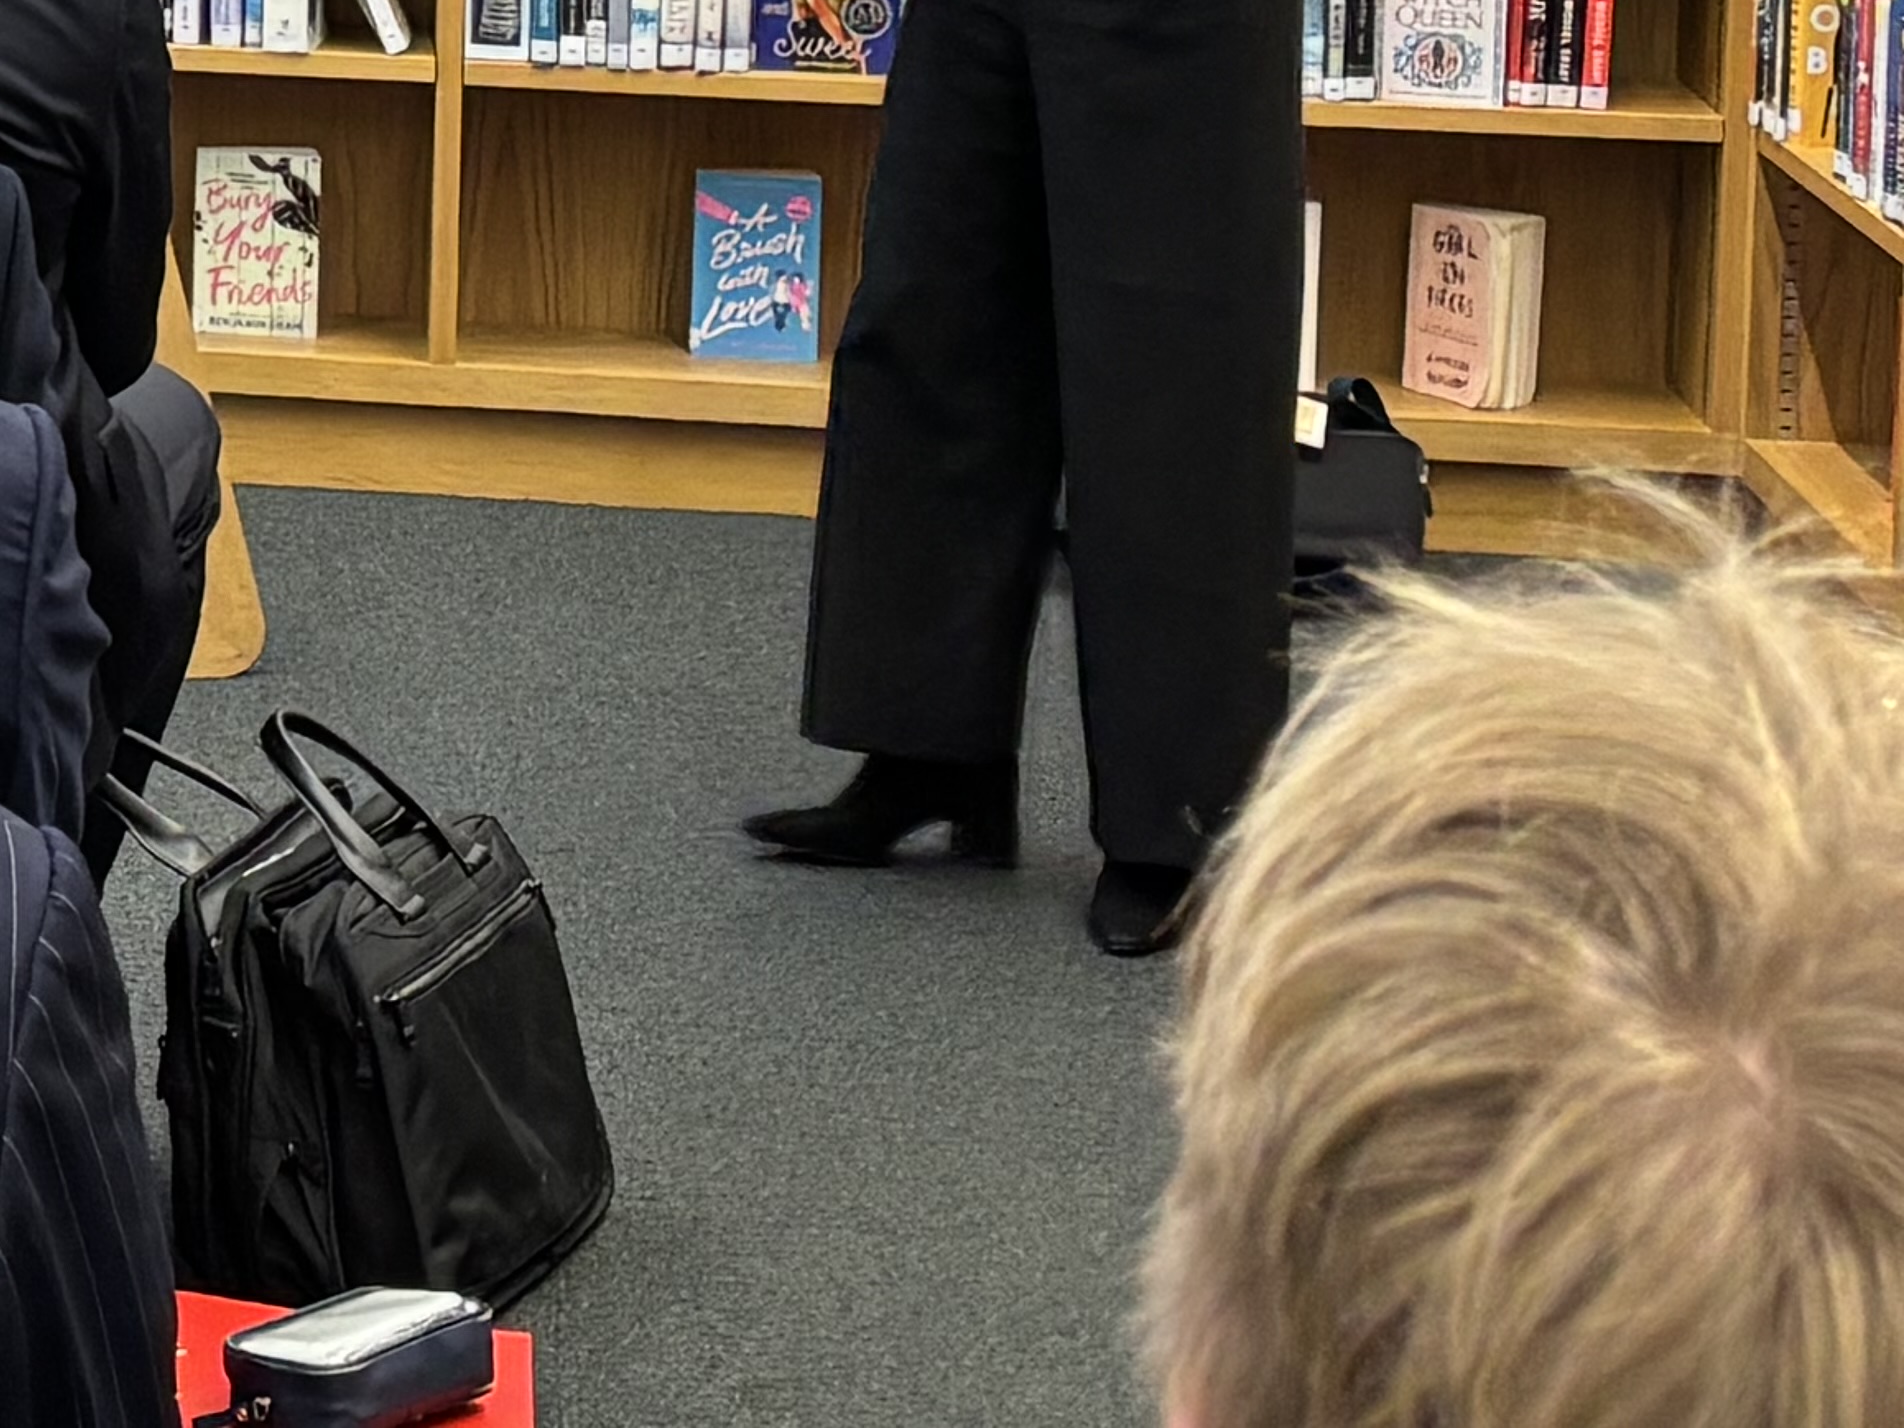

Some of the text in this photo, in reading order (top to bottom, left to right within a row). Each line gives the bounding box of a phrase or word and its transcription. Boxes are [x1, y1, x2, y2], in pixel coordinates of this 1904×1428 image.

[1394, 6, 1485, 30] QUEEN
[203, 177, 277, 233] Bury
[213, 220, 290, 264] Your
[710, 223, 805, 269] Brush
[205, 265, 313, 307] Friends
[699, 294, 777, 340] Love
